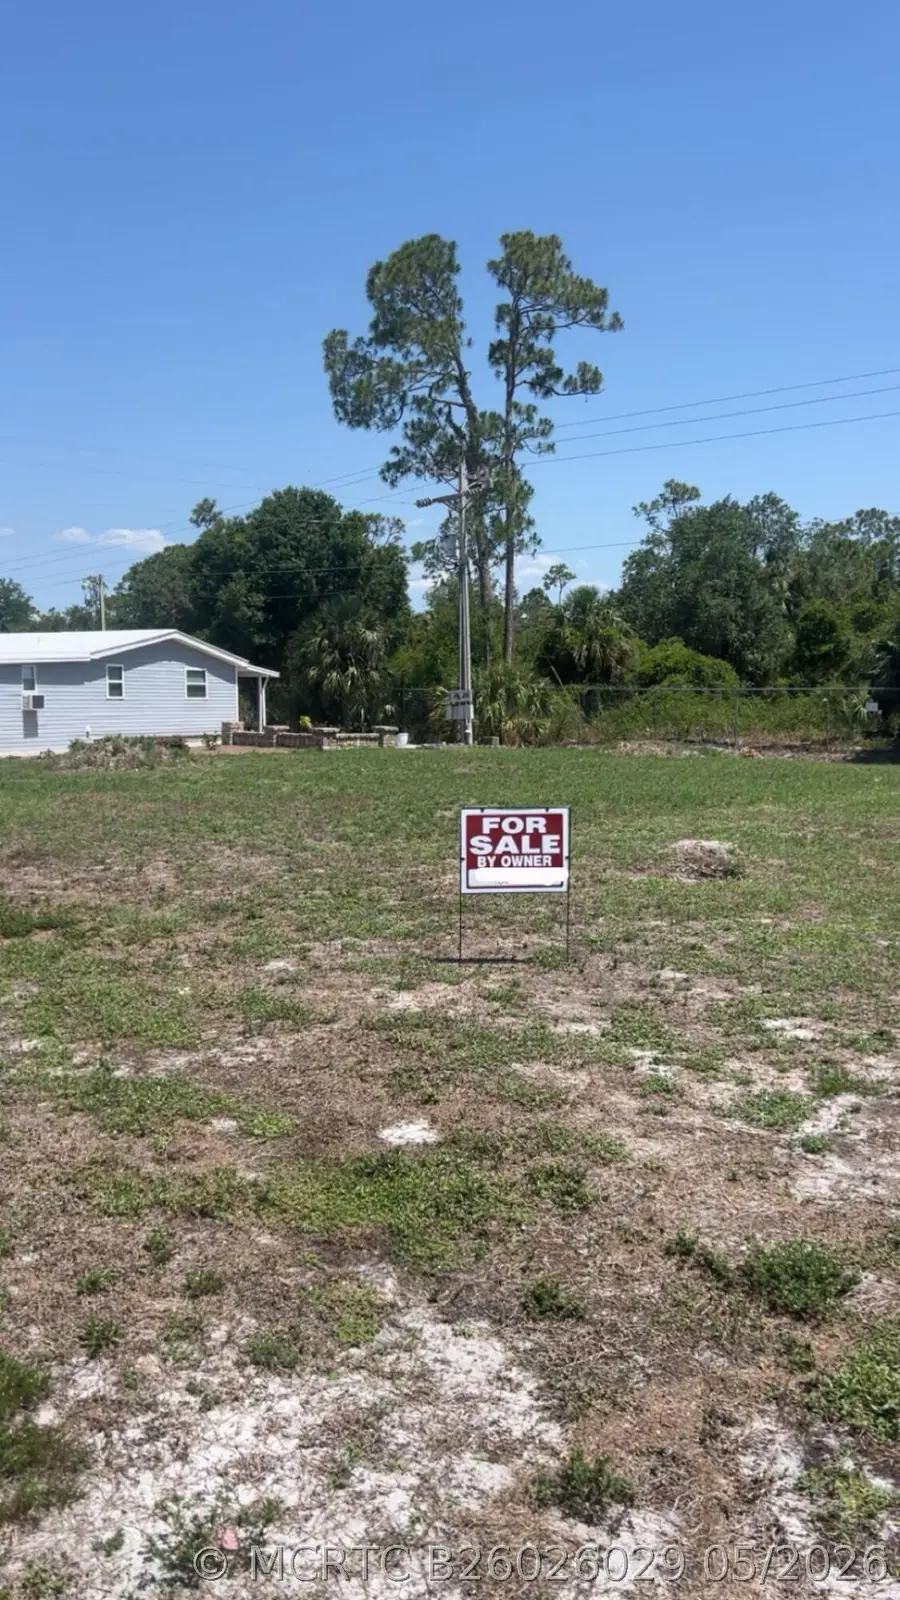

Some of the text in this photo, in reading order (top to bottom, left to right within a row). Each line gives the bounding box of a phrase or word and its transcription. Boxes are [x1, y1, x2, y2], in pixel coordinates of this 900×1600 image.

[482, 816, 547, 834] FOR
[469, 834, 561, 855] SALE
[477, 855, 552, 868] BY OWNER
